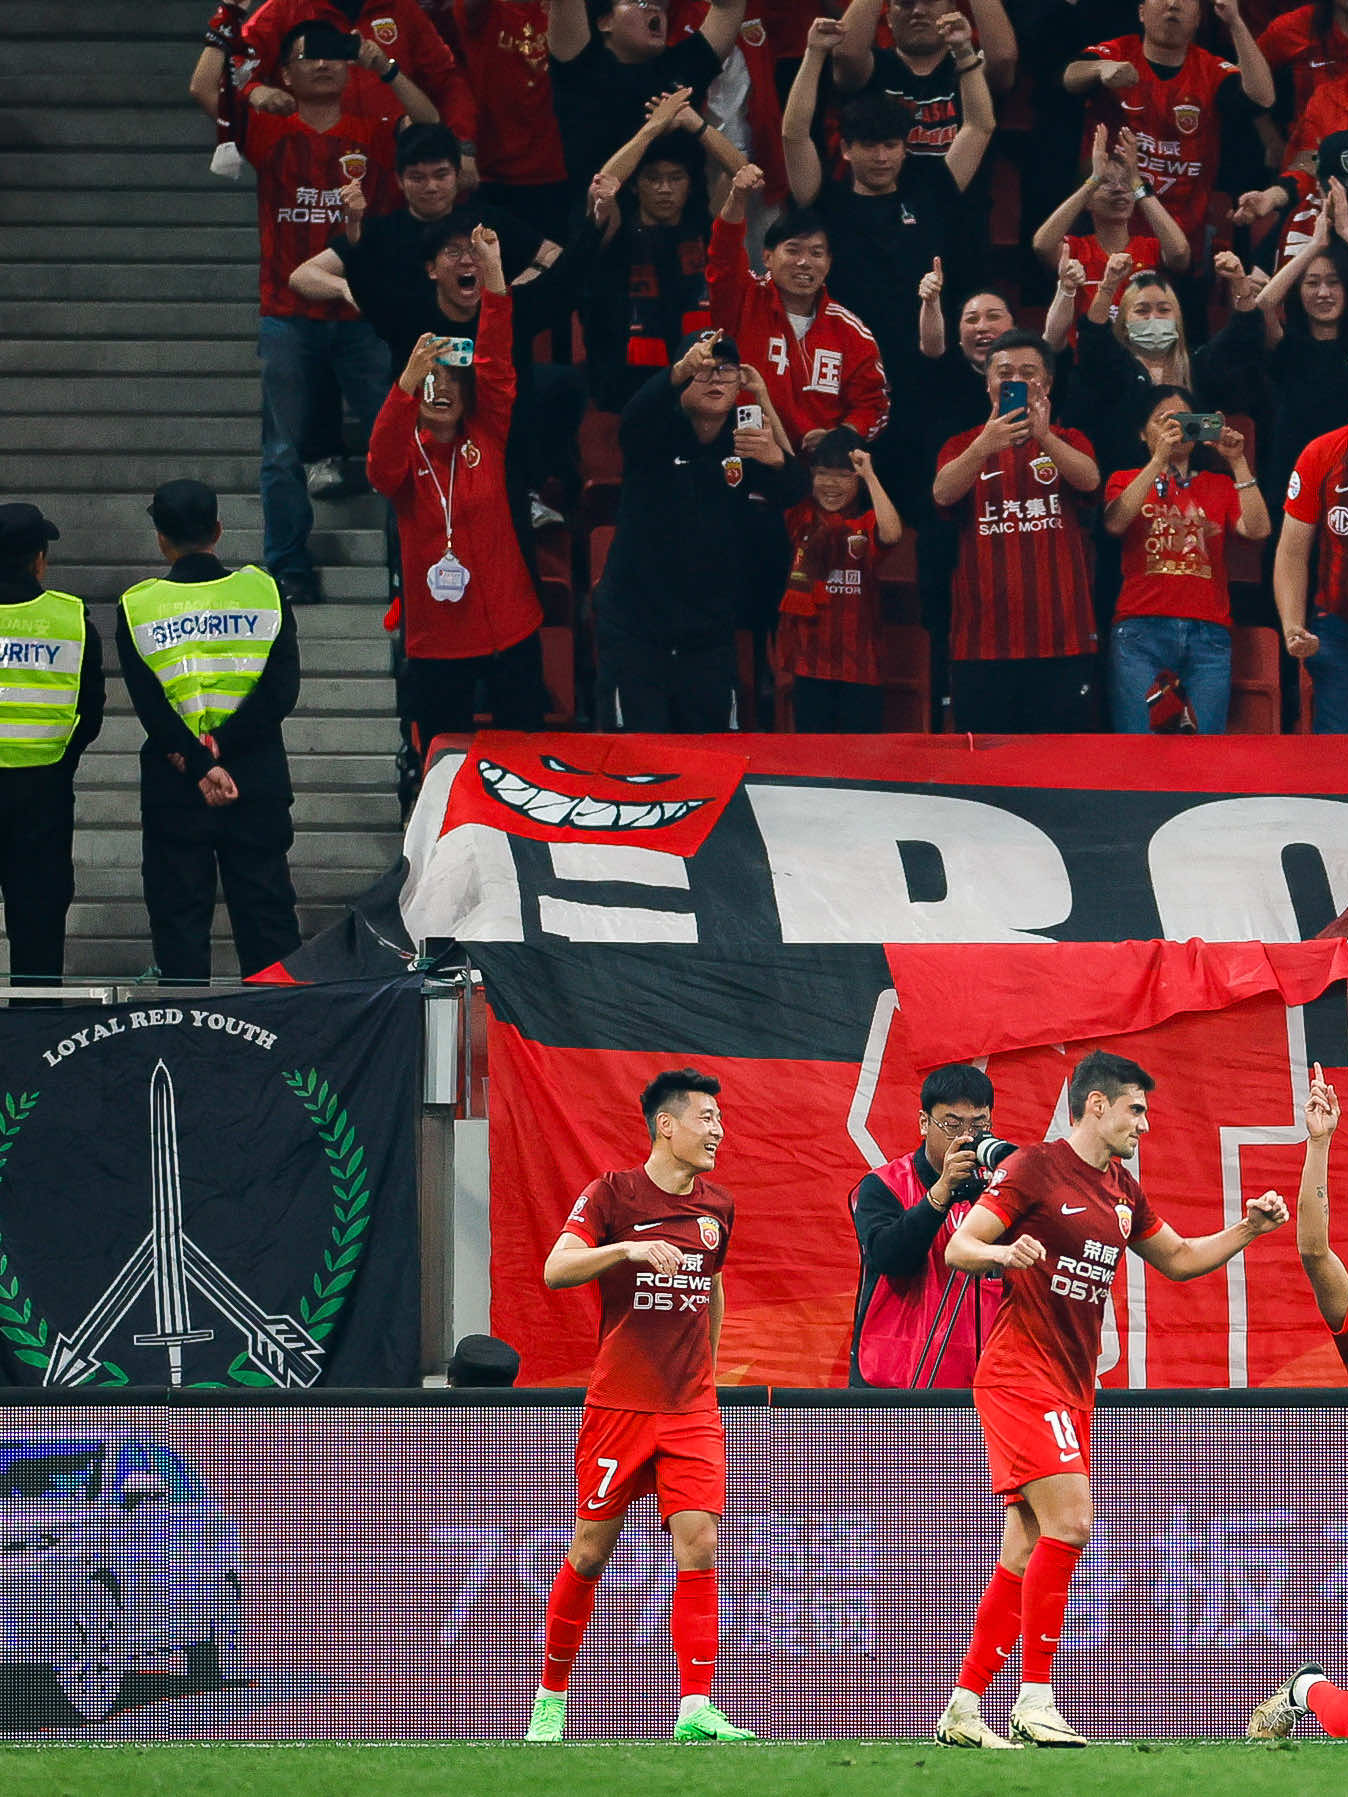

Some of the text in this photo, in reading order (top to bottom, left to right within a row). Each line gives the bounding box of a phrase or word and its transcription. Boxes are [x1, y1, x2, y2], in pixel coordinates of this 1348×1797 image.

[277, 208, 348, 224] ROEW
[979, 520, 1015, 536] SAIC
[826, 586, 862, 594] OTOR
[152, 614, 259, 645] SECURITY
[42, 1008, 279, 1067] LOYAL RED YOUTH
[682, 1253, 704, 1272] 威
[1083, 1240, 1120, 1266] 荣威
[636, 1272, 712, 1291] ROEWE
[633, 1291, 673, 1311] D5
[597, 1457, 618, 1498] 7
